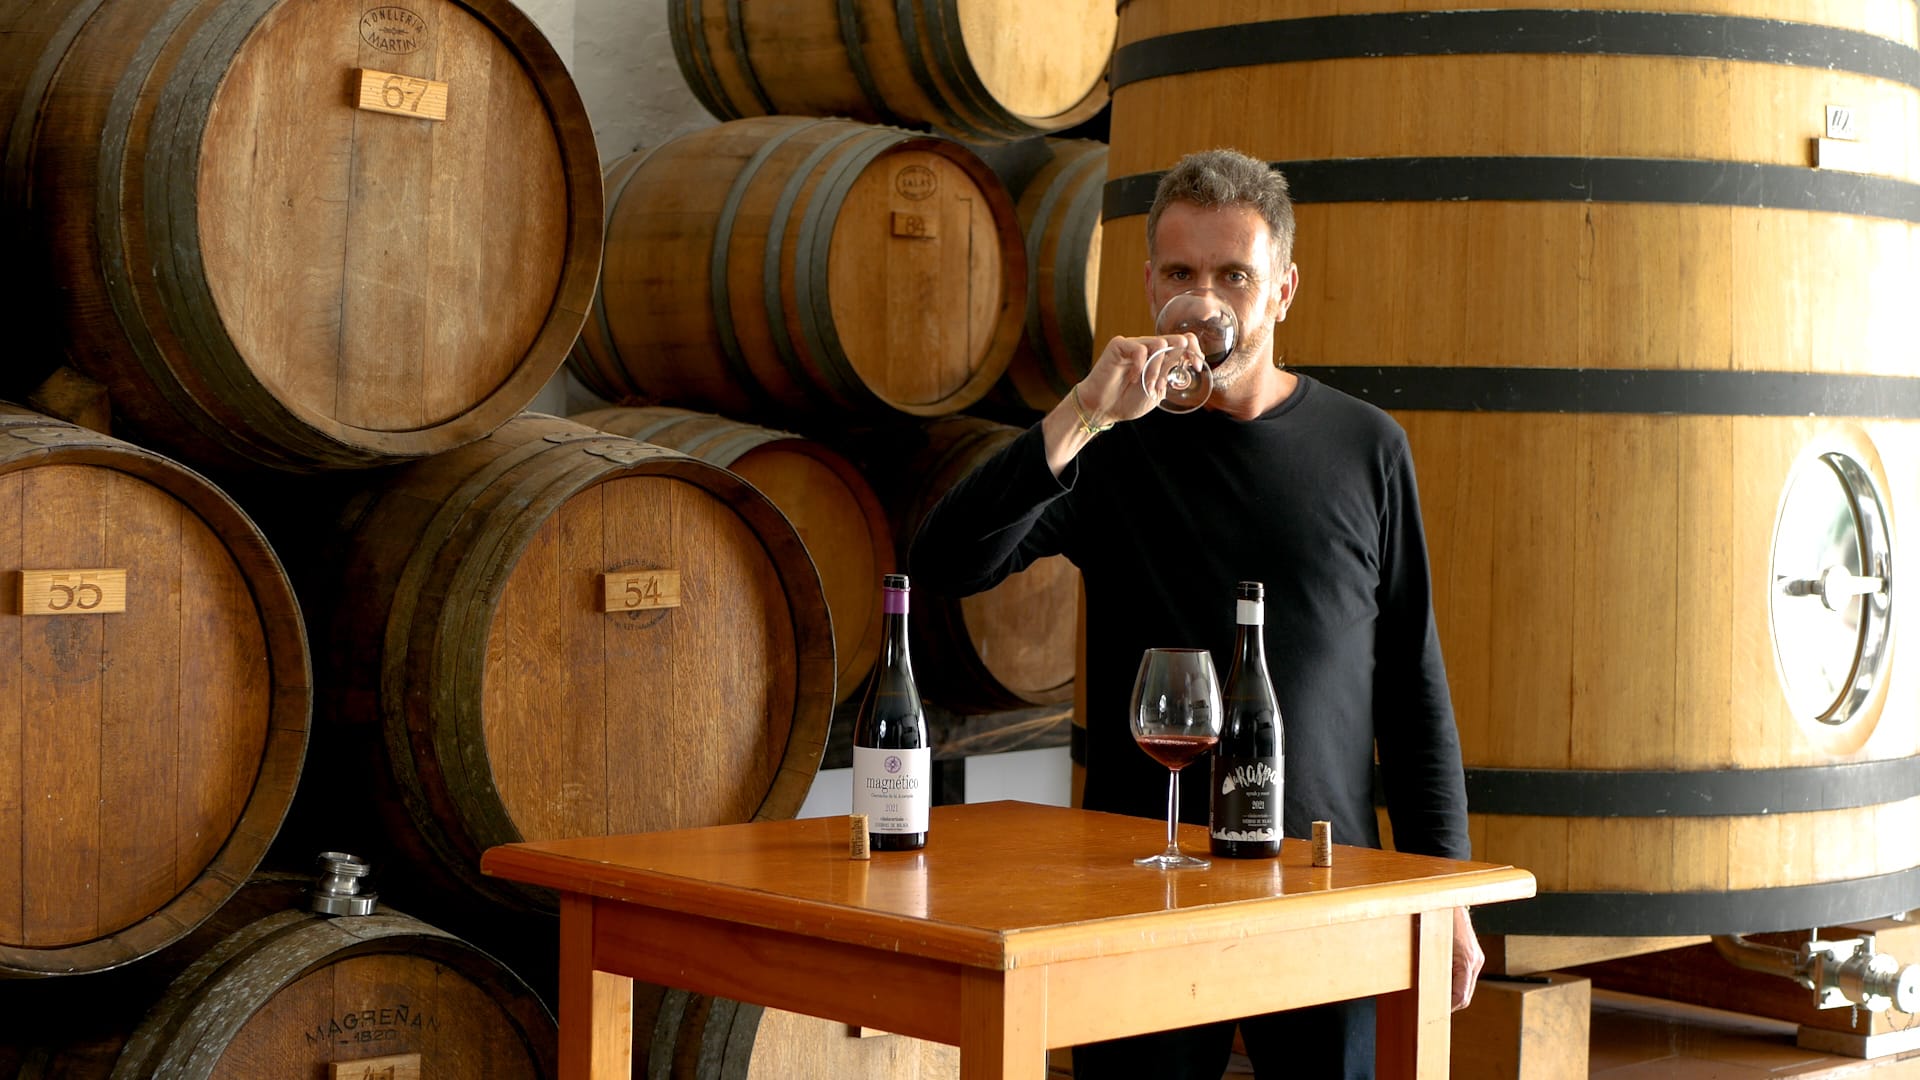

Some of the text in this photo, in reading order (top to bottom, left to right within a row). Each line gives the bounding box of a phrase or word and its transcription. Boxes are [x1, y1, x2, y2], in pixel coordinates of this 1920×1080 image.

[368, 32, 418, 52] MARTIN
[382, 75, 429, 112] 67
[48, 574, 103, 611] 55
[624, 575, 663, 608] 54
[865, 774, 919, 794] magnético
[884, 803, 898, 813] 2021
[1251, 800, 1265, 810] 2021
